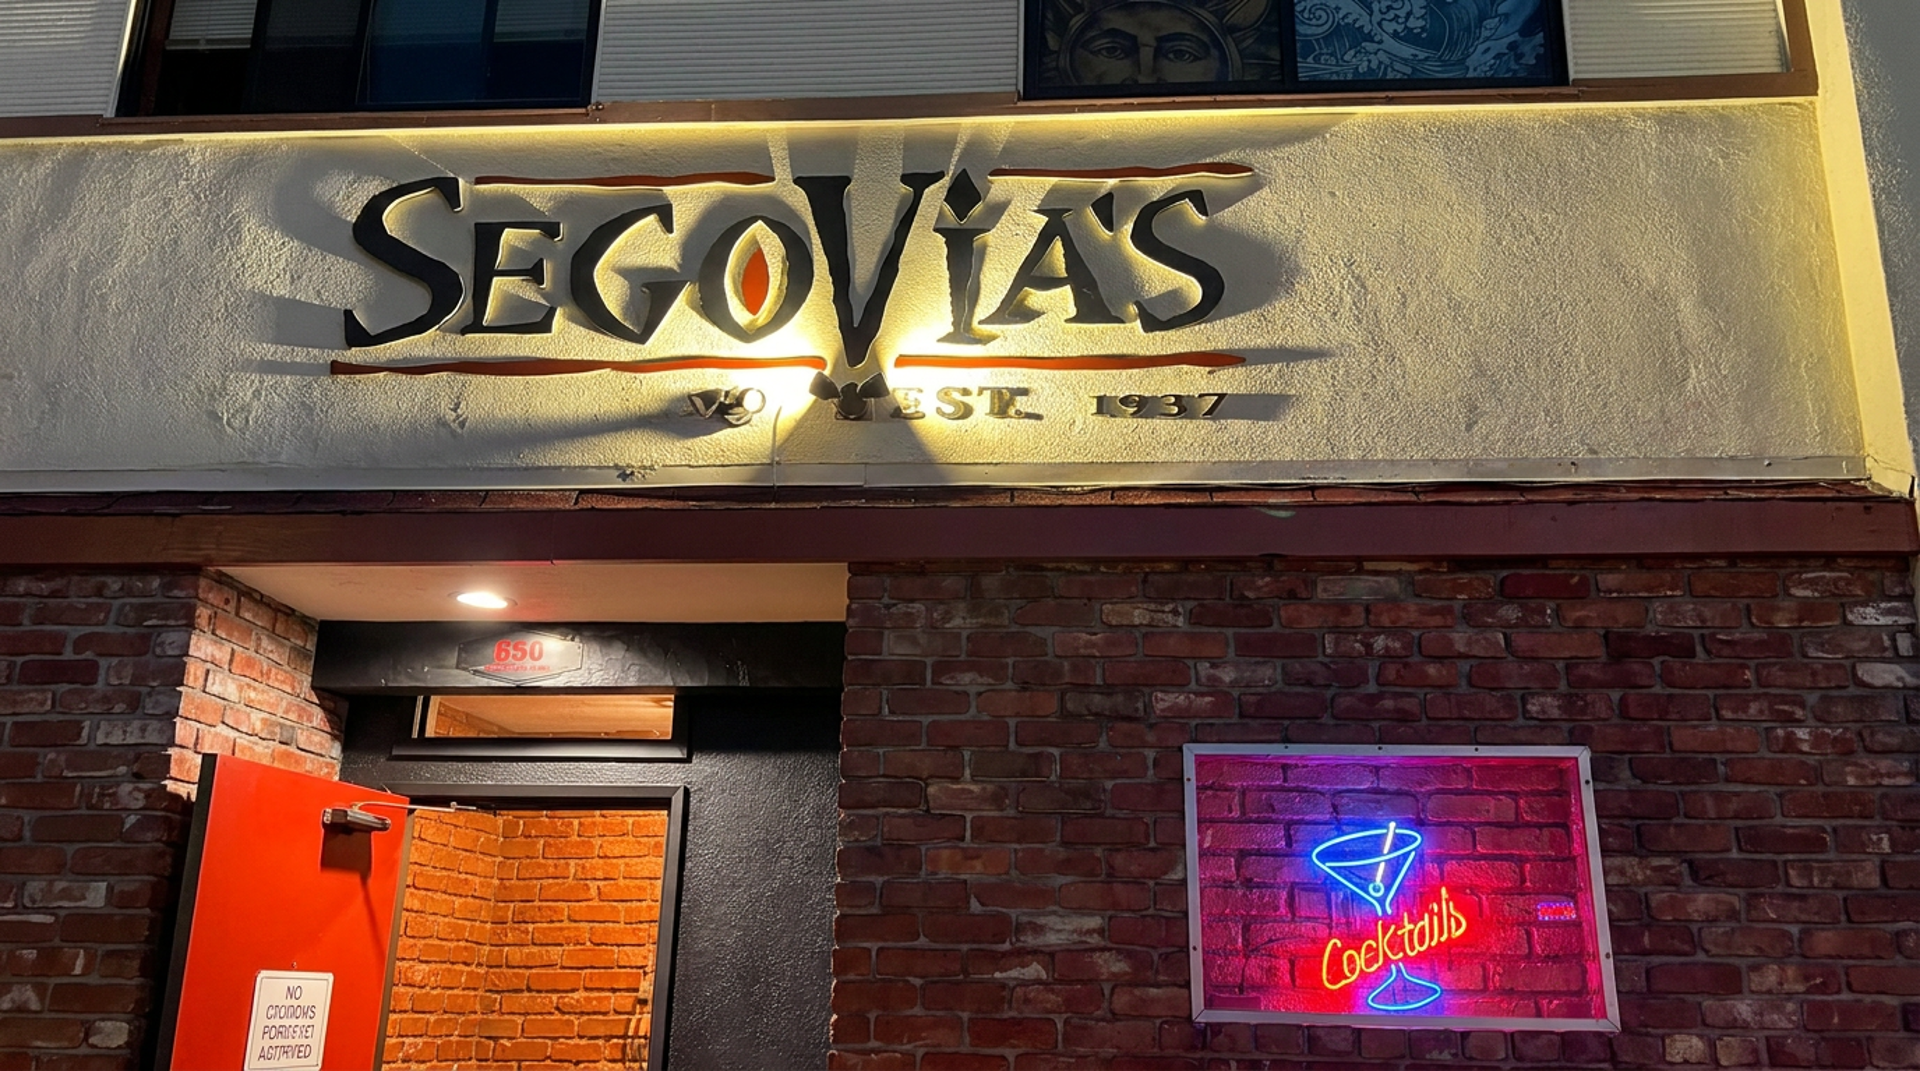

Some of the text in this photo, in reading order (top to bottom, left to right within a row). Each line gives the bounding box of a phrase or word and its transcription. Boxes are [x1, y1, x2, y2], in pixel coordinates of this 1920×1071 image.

[1088, 392, 1229, 419] 1937
[493, 638, 545, 663] 650
[1322, 886, 1467, 990] Cocktails
[285, 985, 303, 1001] NO
